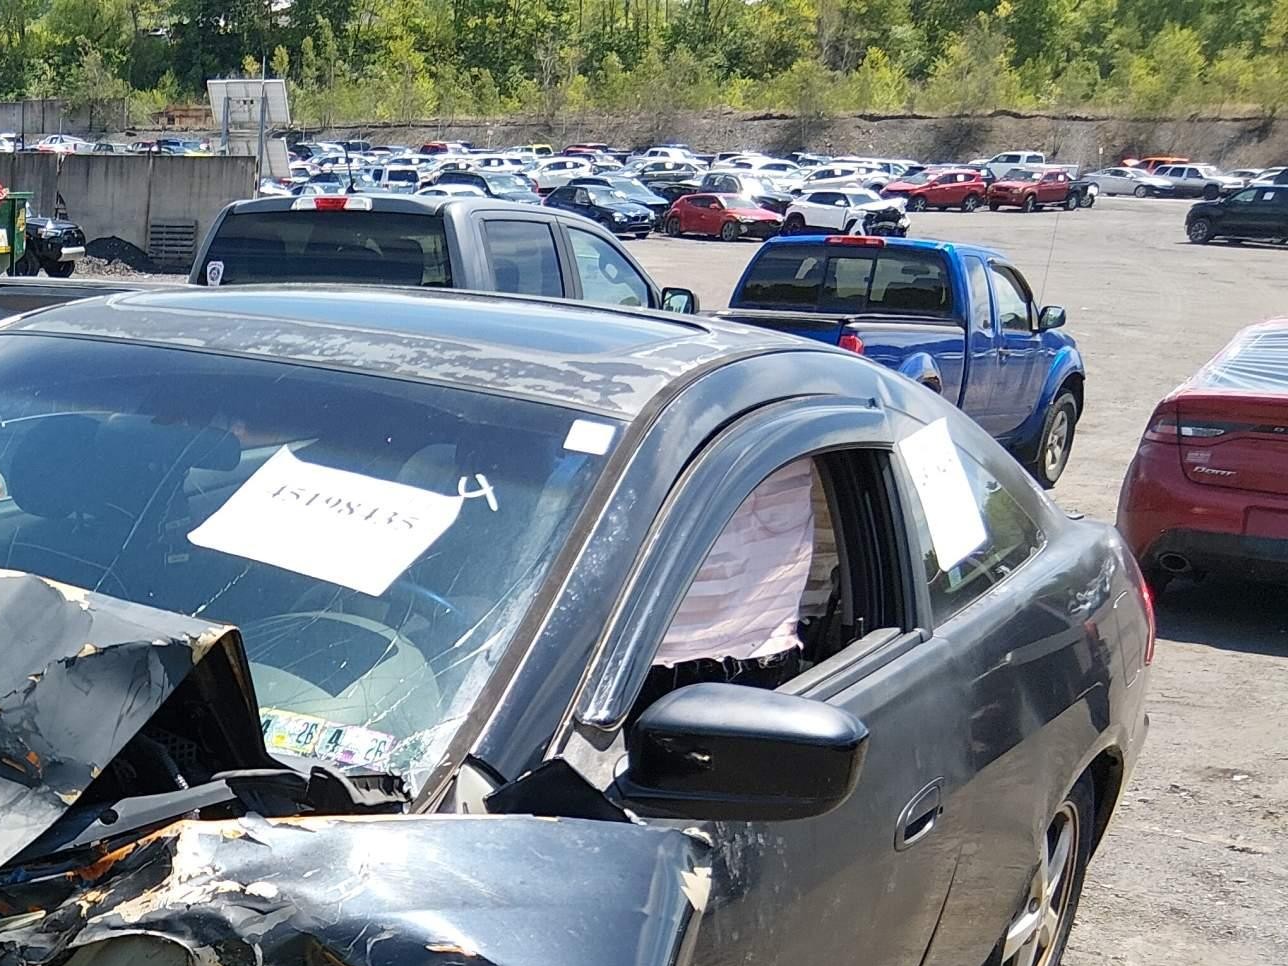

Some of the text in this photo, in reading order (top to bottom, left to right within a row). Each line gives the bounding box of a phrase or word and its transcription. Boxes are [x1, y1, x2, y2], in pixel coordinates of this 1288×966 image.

[271, 484, 420, 530] 45198435
[295, 721, 319, 745] 26
[326, 728, 344, 753] 4
